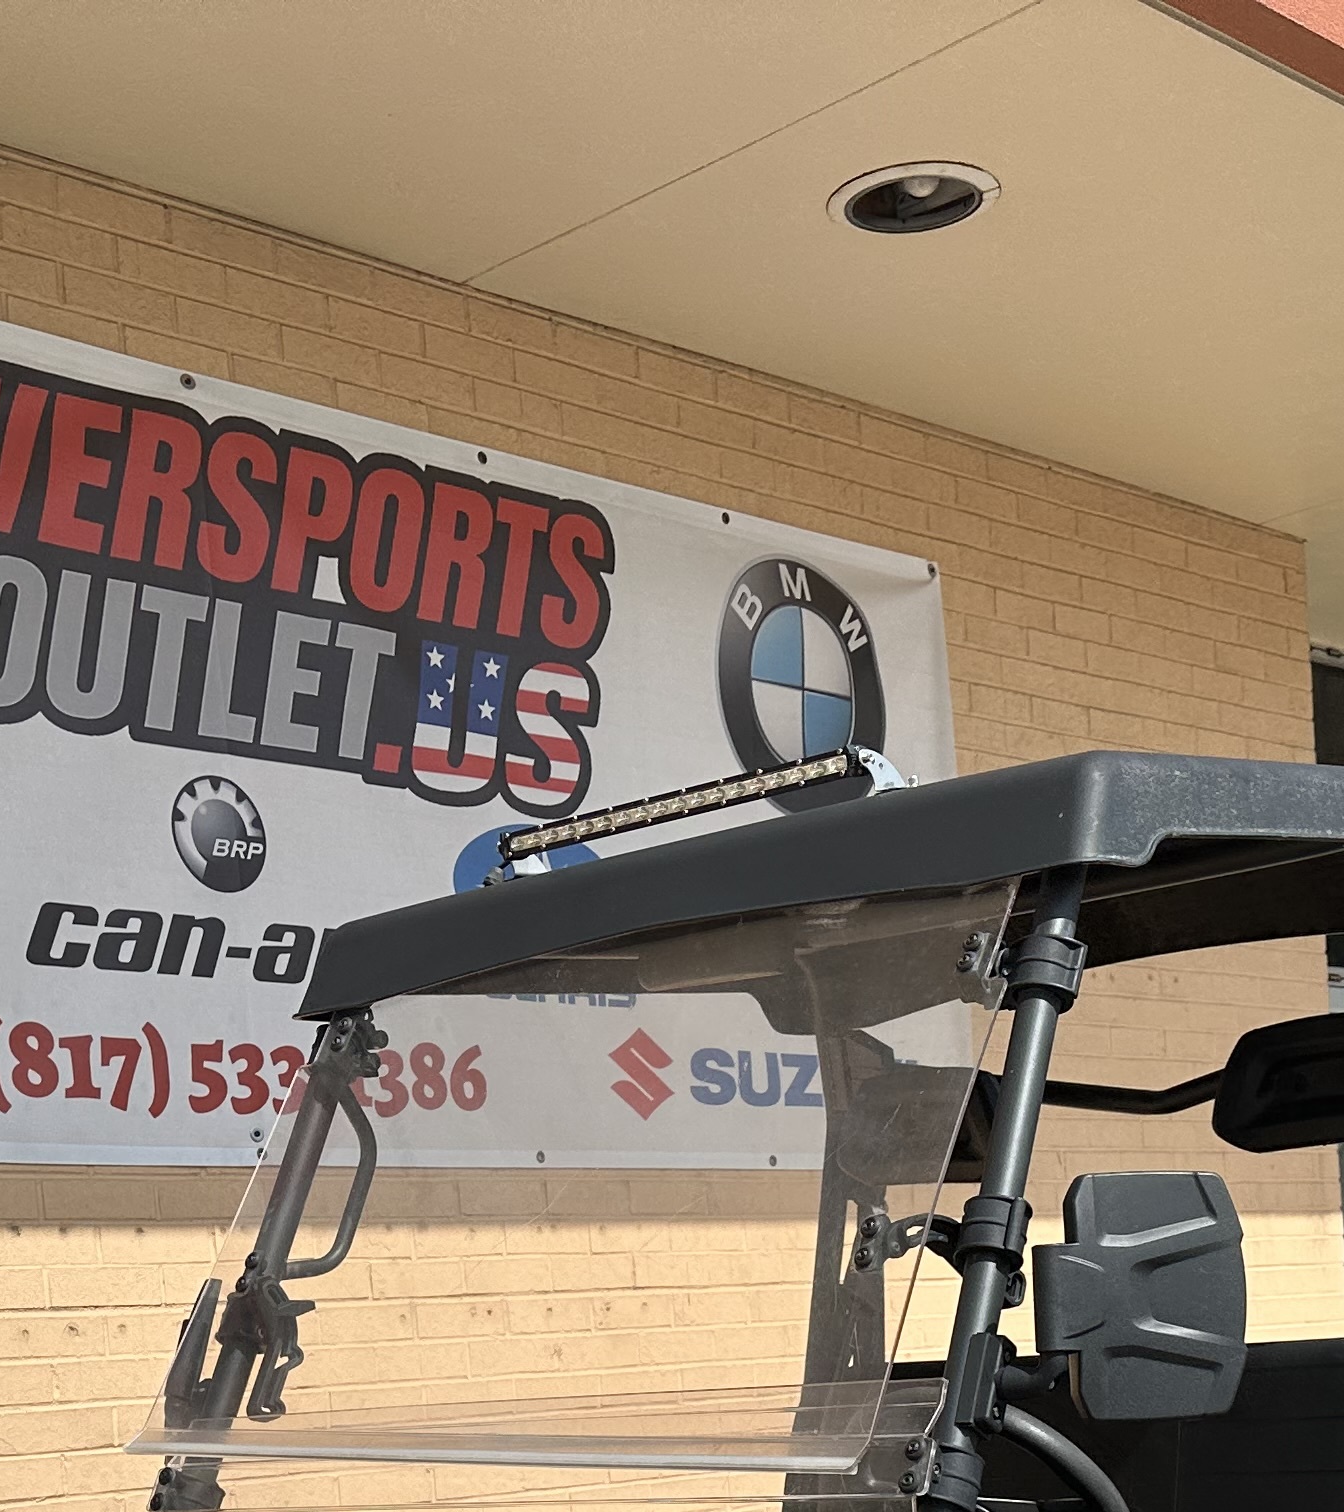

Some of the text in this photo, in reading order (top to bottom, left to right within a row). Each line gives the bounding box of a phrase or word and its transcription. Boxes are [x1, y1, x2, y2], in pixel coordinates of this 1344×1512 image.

[731, 562, 868, 653] BMW
[211, 837, 264, 861] BRP
[25, 901, 336, 985] can-a
